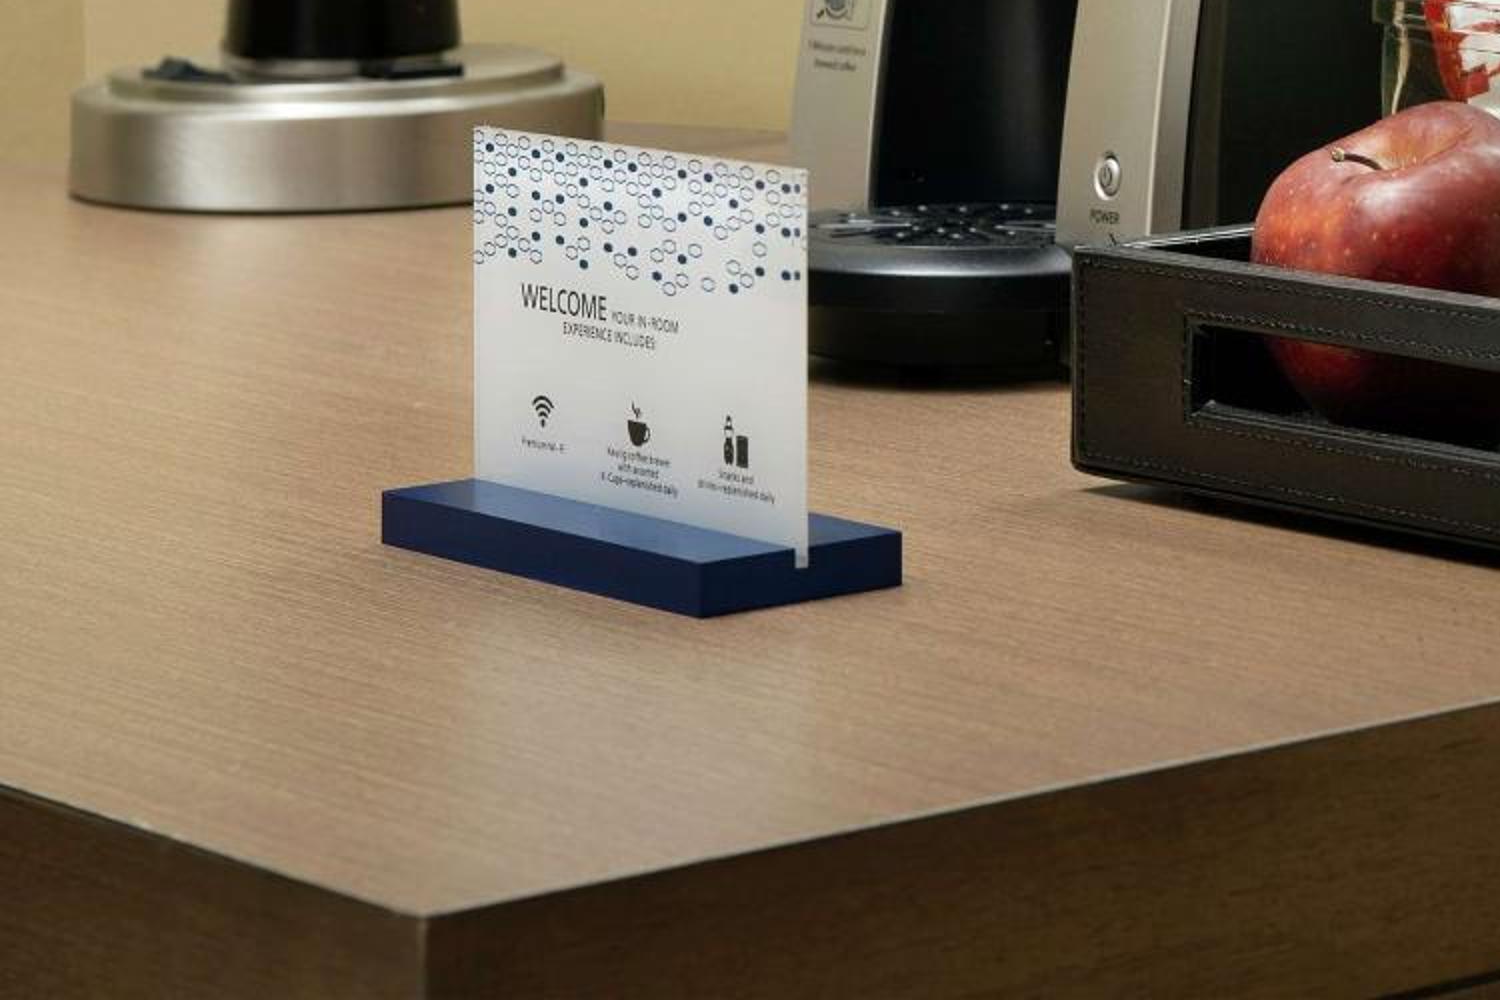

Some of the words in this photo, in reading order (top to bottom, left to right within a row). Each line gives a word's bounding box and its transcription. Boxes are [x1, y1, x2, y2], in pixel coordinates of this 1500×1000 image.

[521, 282, 608, 322] WELCOME
[562, 321, 612, 343] EXPERIENCE
[615, 331, 656, 351] INCLUDES
